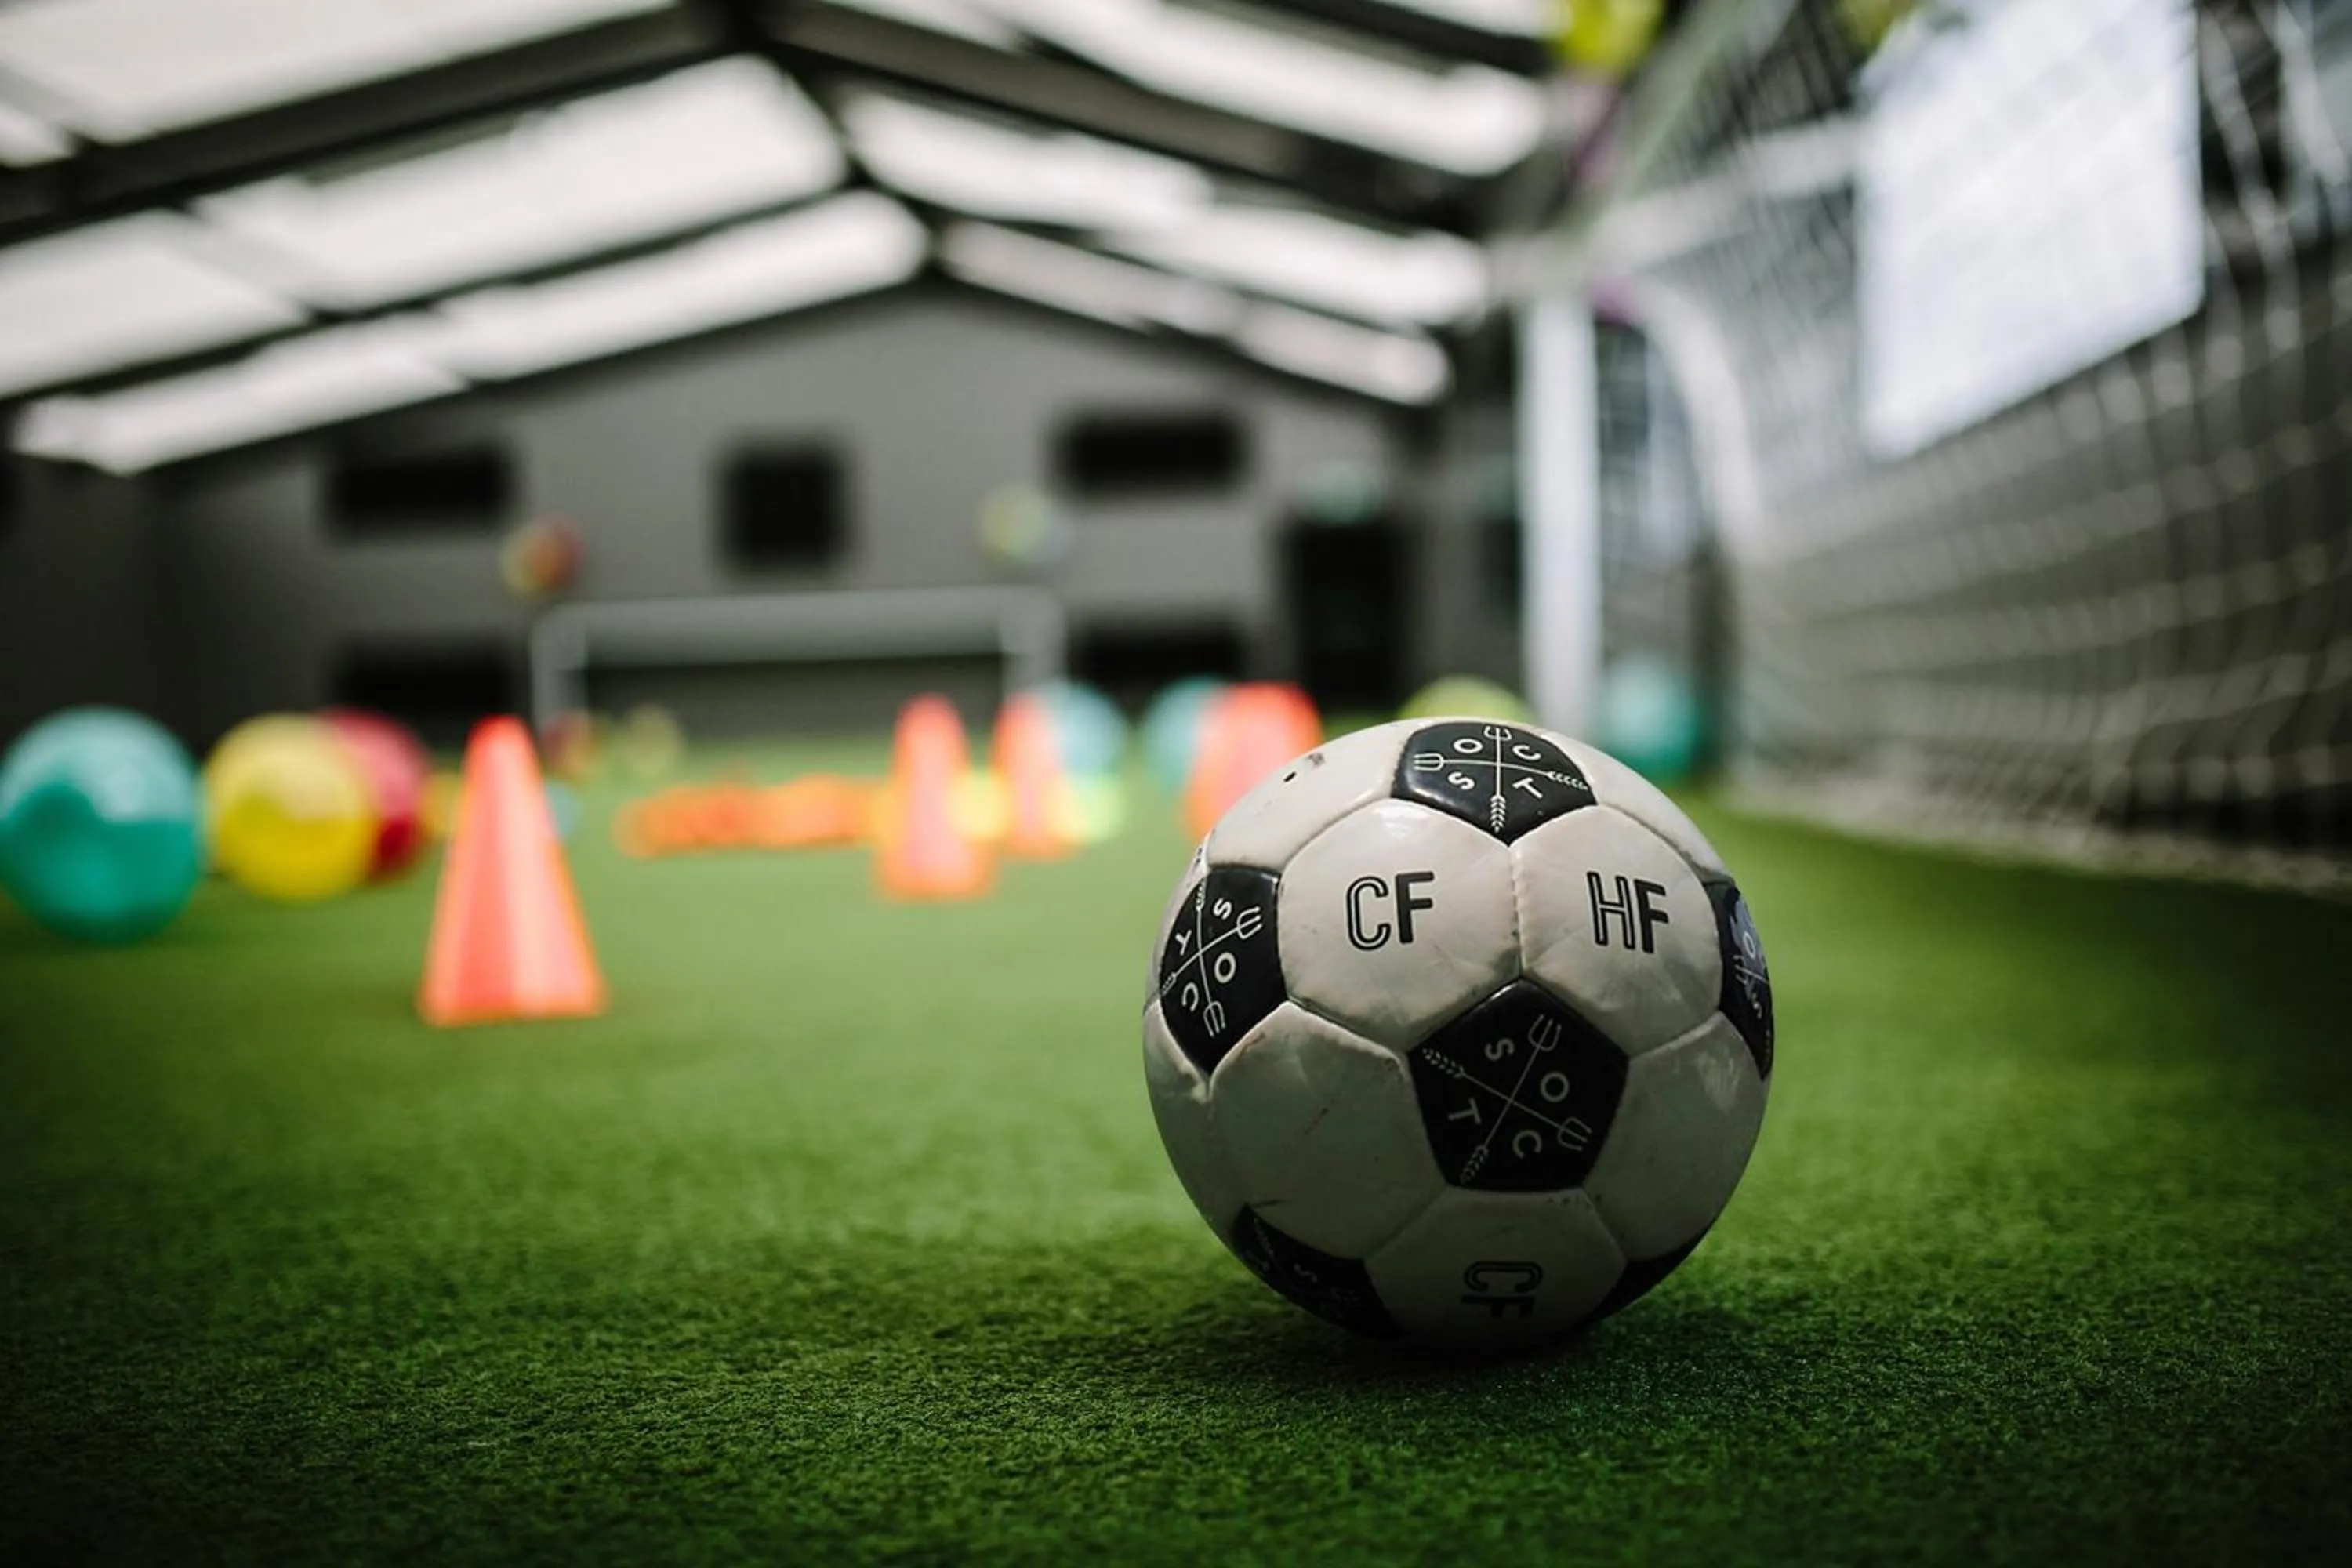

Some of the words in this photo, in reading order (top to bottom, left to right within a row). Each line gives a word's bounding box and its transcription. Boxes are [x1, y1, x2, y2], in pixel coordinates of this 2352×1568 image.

[1346, 871, 1435, 951] CF
[1587, 871, 1669, 953] HF
[1461, 1260, 1543, 1318] CF
